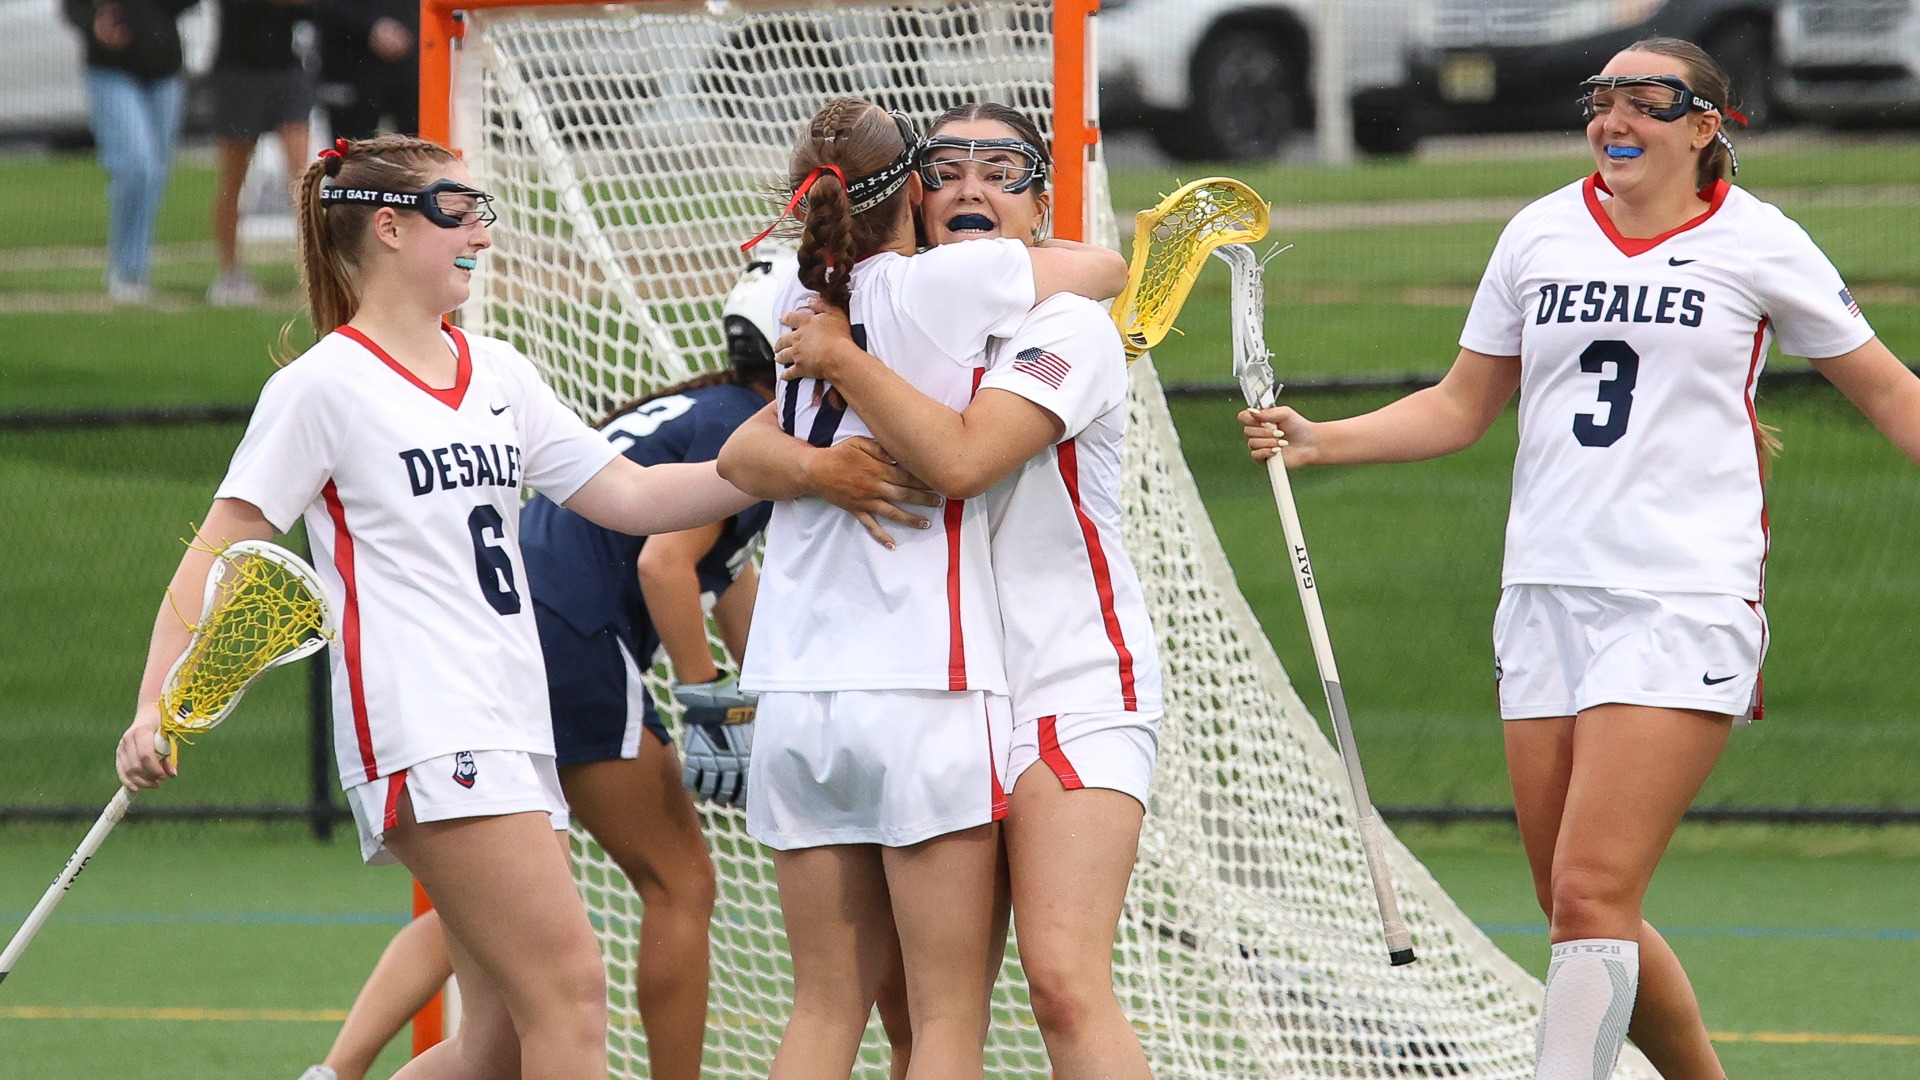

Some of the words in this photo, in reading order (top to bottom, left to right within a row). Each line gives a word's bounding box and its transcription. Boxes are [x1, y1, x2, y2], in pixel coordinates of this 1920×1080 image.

[1692, 96, 1714, 111] GAIT
[346, 189, 378, 201] GAIT
[382, 192, 418, 205] GAIT
[1535, 280, 1706, 328] DESALES
[1572, 340, 1640, 448] 3
[467, 504, 521, 616] 6
[1294, 545, 1314, 589] GAIT
